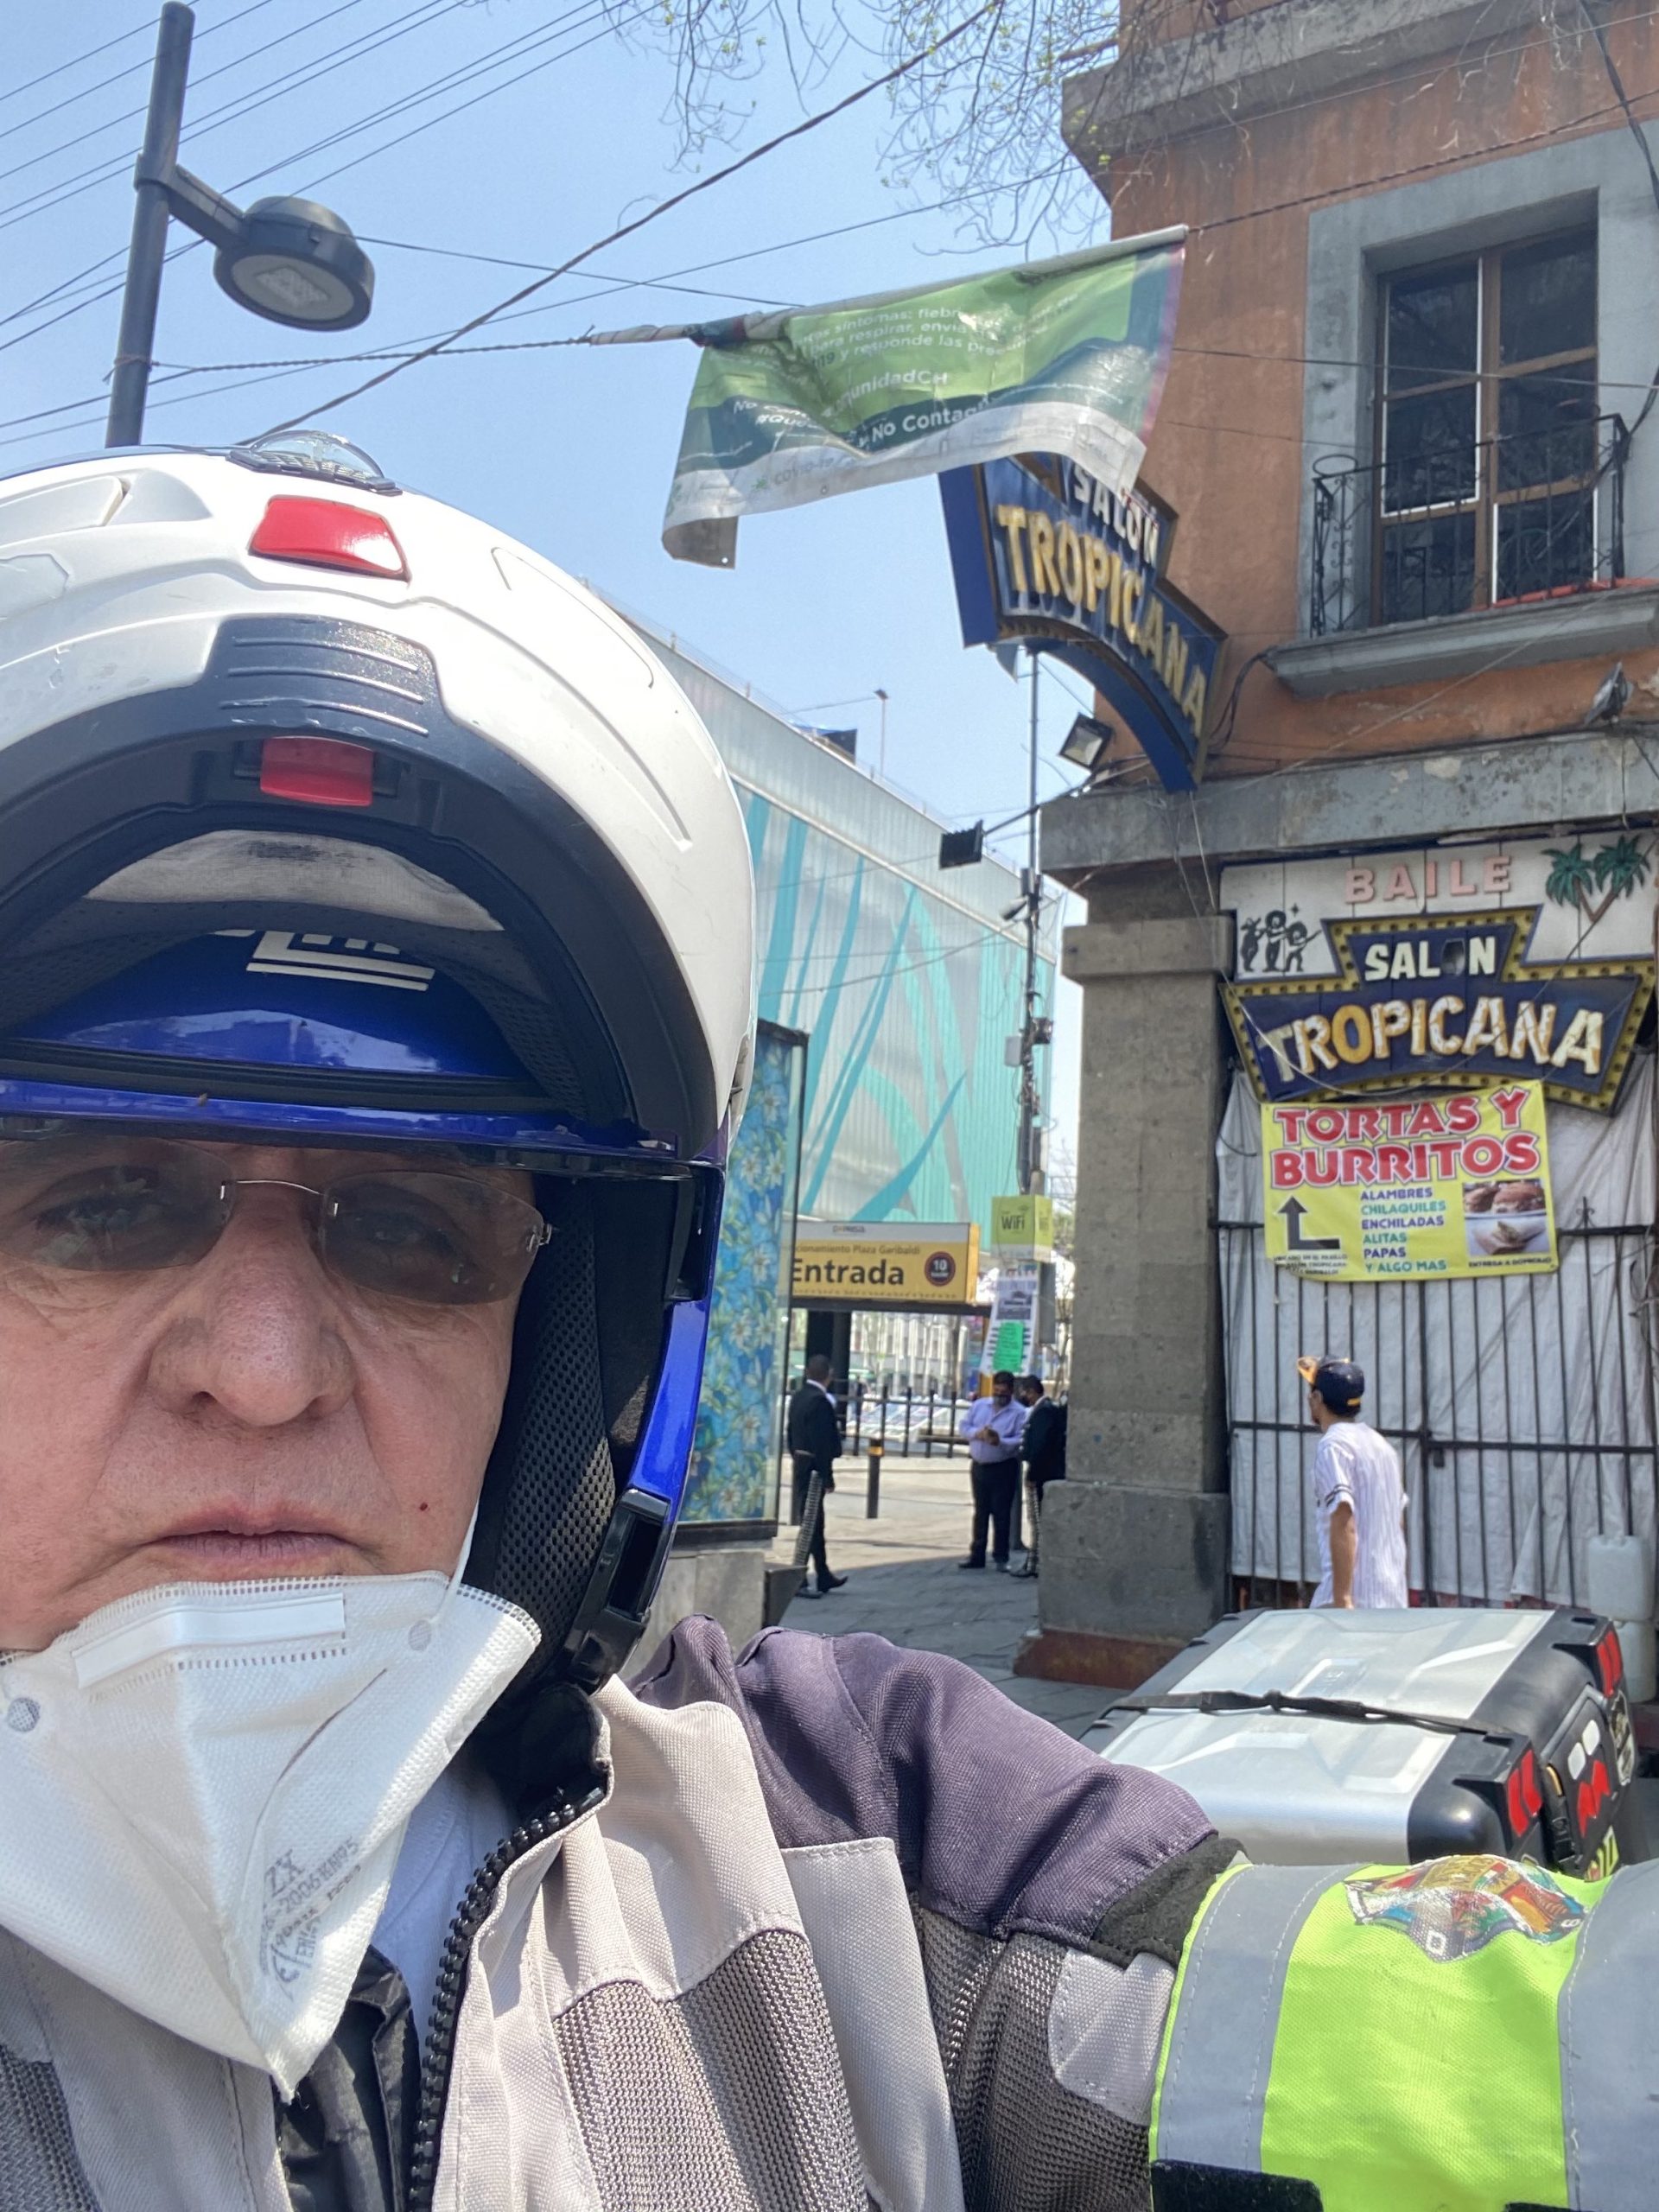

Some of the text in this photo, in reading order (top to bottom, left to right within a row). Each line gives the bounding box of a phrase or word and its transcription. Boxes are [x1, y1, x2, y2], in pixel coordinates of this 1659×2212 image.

[854, 334, 933, 355] responde
[939, 334, 963, 347] las
[872, 424, 898, 444] No
[997, 504, 1207, 739] TROPICANA
[1344, 855, 1512, 904] BAILE
[1364, 937, 1496, 982] SALN
[1257, 995, 1603, 1083] TROPICANA
[1274, 1086, 1530, 1146] TORTAS Y
[1271, 1132, 1541, 1189] BURRITOS
[1360, 1187, 1433, 1200] ALAMBRES
[1361, 1200, 1446, 1215] CHILAQUILES
[1362, 1216, 1444, 1230] ENCHILADAS
[1363, 1232, 1407, 1244] ALITAS
[1363, 1247, 1407, 1259] PAPAS
[792, 1259, 904, 1285] Entrada
[932, 1259, 948, 1270] 10
[1366, 1260, 1446, 1273] Y ALGO MAS
